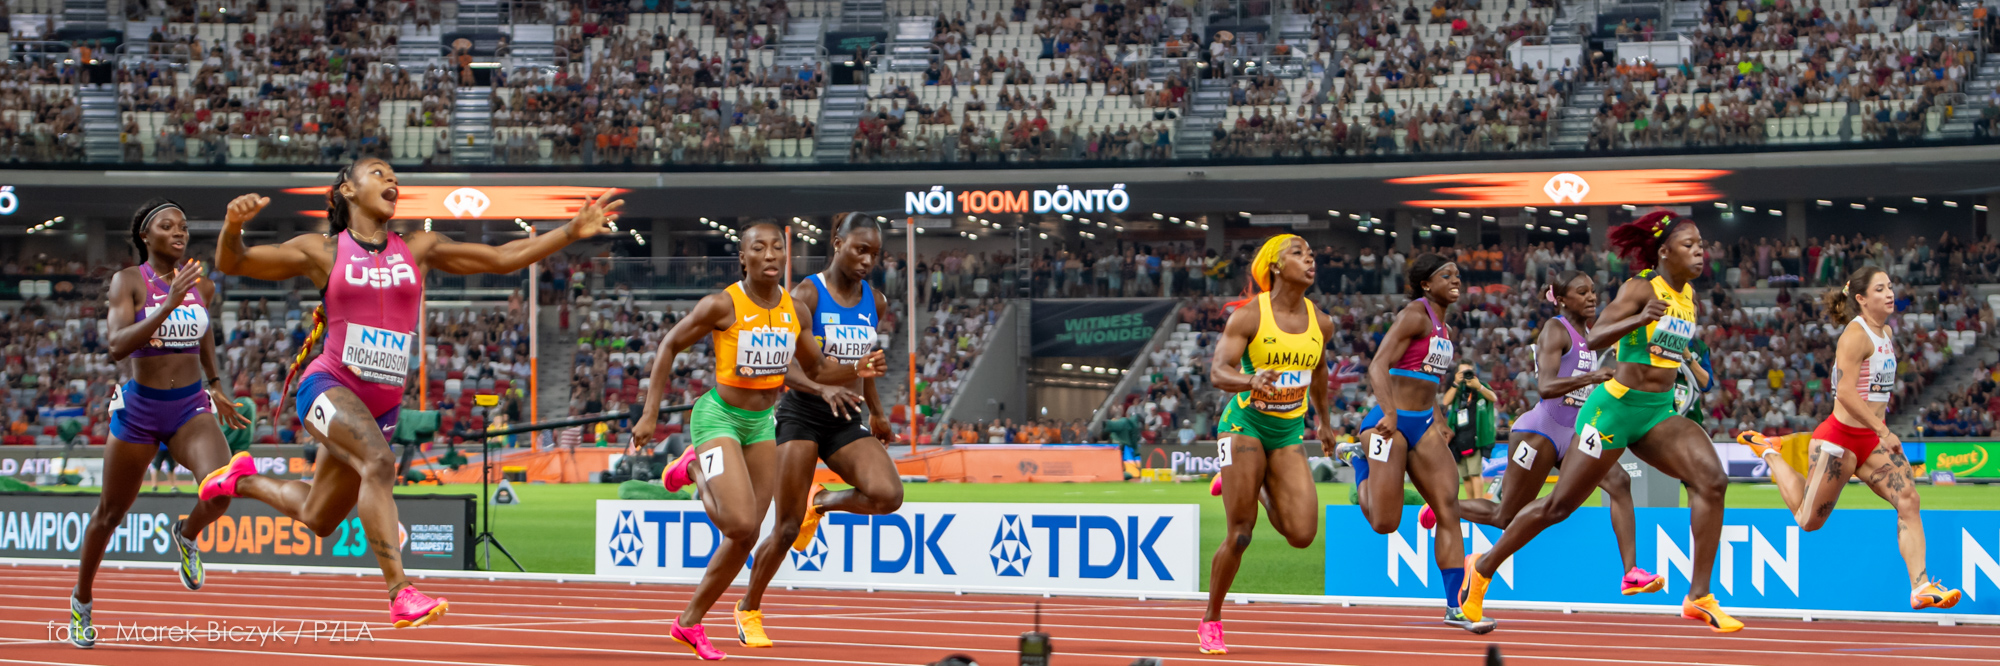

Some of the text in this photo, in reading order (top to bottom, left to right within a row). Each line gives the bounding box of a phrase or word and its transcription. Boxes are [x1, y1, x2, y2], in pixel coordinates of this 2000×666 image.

[905, 184, 1130, 214] NŐI 100M DÖNTŐ
[345, 263, 416, 288] USA
[158, 324, 198, 337] DAVIS
[1064, 313, 1144, 331] WITNESS
[1668, 318, 1691, 335] NTN
[361, 327, 406, 351] NTN
[751, 333, 787, 348] NTN
[836, 326, 869, 340] NTN
[1075, 326, 1155, 344] WONDER
[346, 345, 407, 372] RICHARDSON
[745, 350, 789, 364] TA LOU
[1265, 352, 1318, 368] JAMAICA
[1272, 371, 1301, 386] TN
[315, 404, 326, 425] 9
[1374, 439, 1382, 455] 3
[1585, 432, 1595, 451] 4
[705, 453, 714, 474] 7
[1171, 451, 1220, 473] Pinse
[1518, 446, 1528, 464] 2
[1936, 450, 1978, 468] Sport
[0, 511, 170, 554] AMPIOHIPS
[178, 515, 367, 557] UDAPES 23
[411, 541, 444, 551] BUDAPEST
[828, 512, 957, 575] TDK
[1031, 514, 1175, 581] TDK
[1656, 523, 1799, 598] NTN
